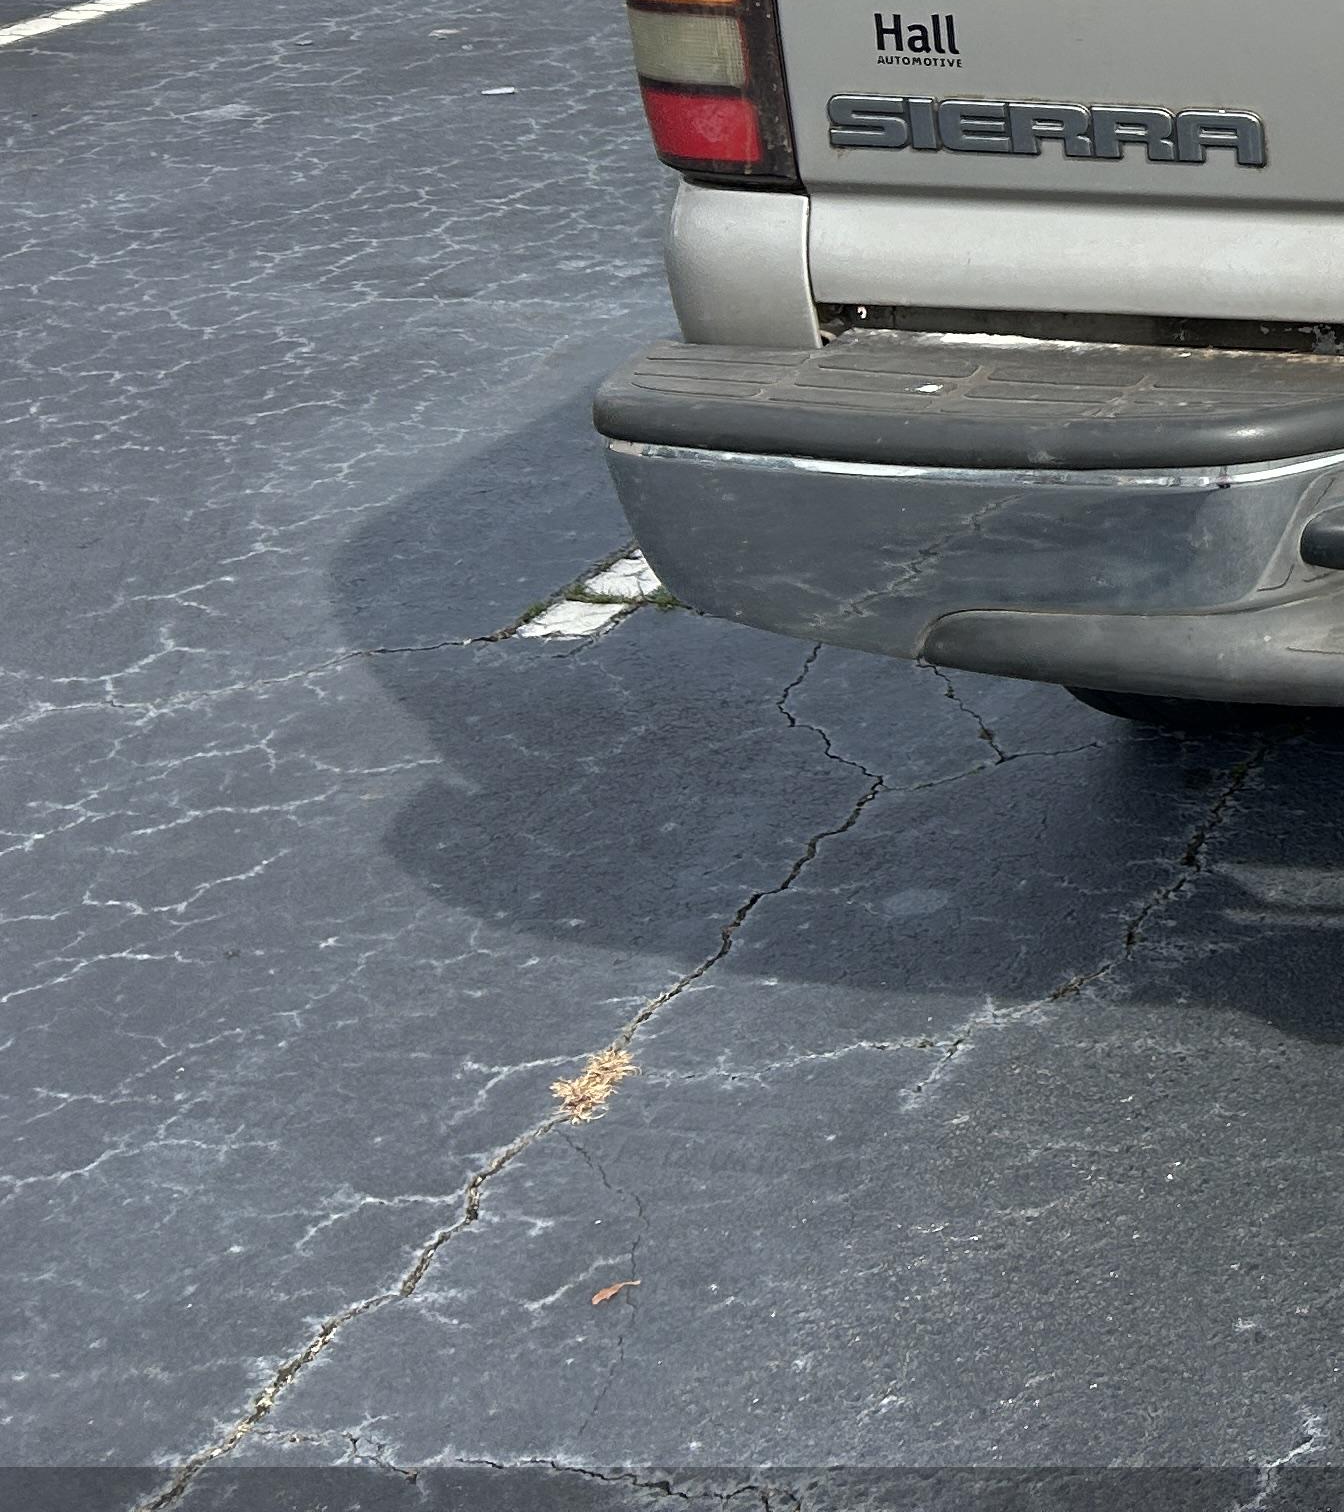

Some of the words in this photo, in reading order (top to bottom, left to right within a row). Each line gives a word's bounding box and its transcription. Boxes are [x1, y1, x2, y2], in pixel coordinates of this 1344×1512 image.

[874, 13, 960, 56] Hall
[877, 55, 963, 68] AUTOMOTIVE
[827, 94, 1267, 168] SIERRA
